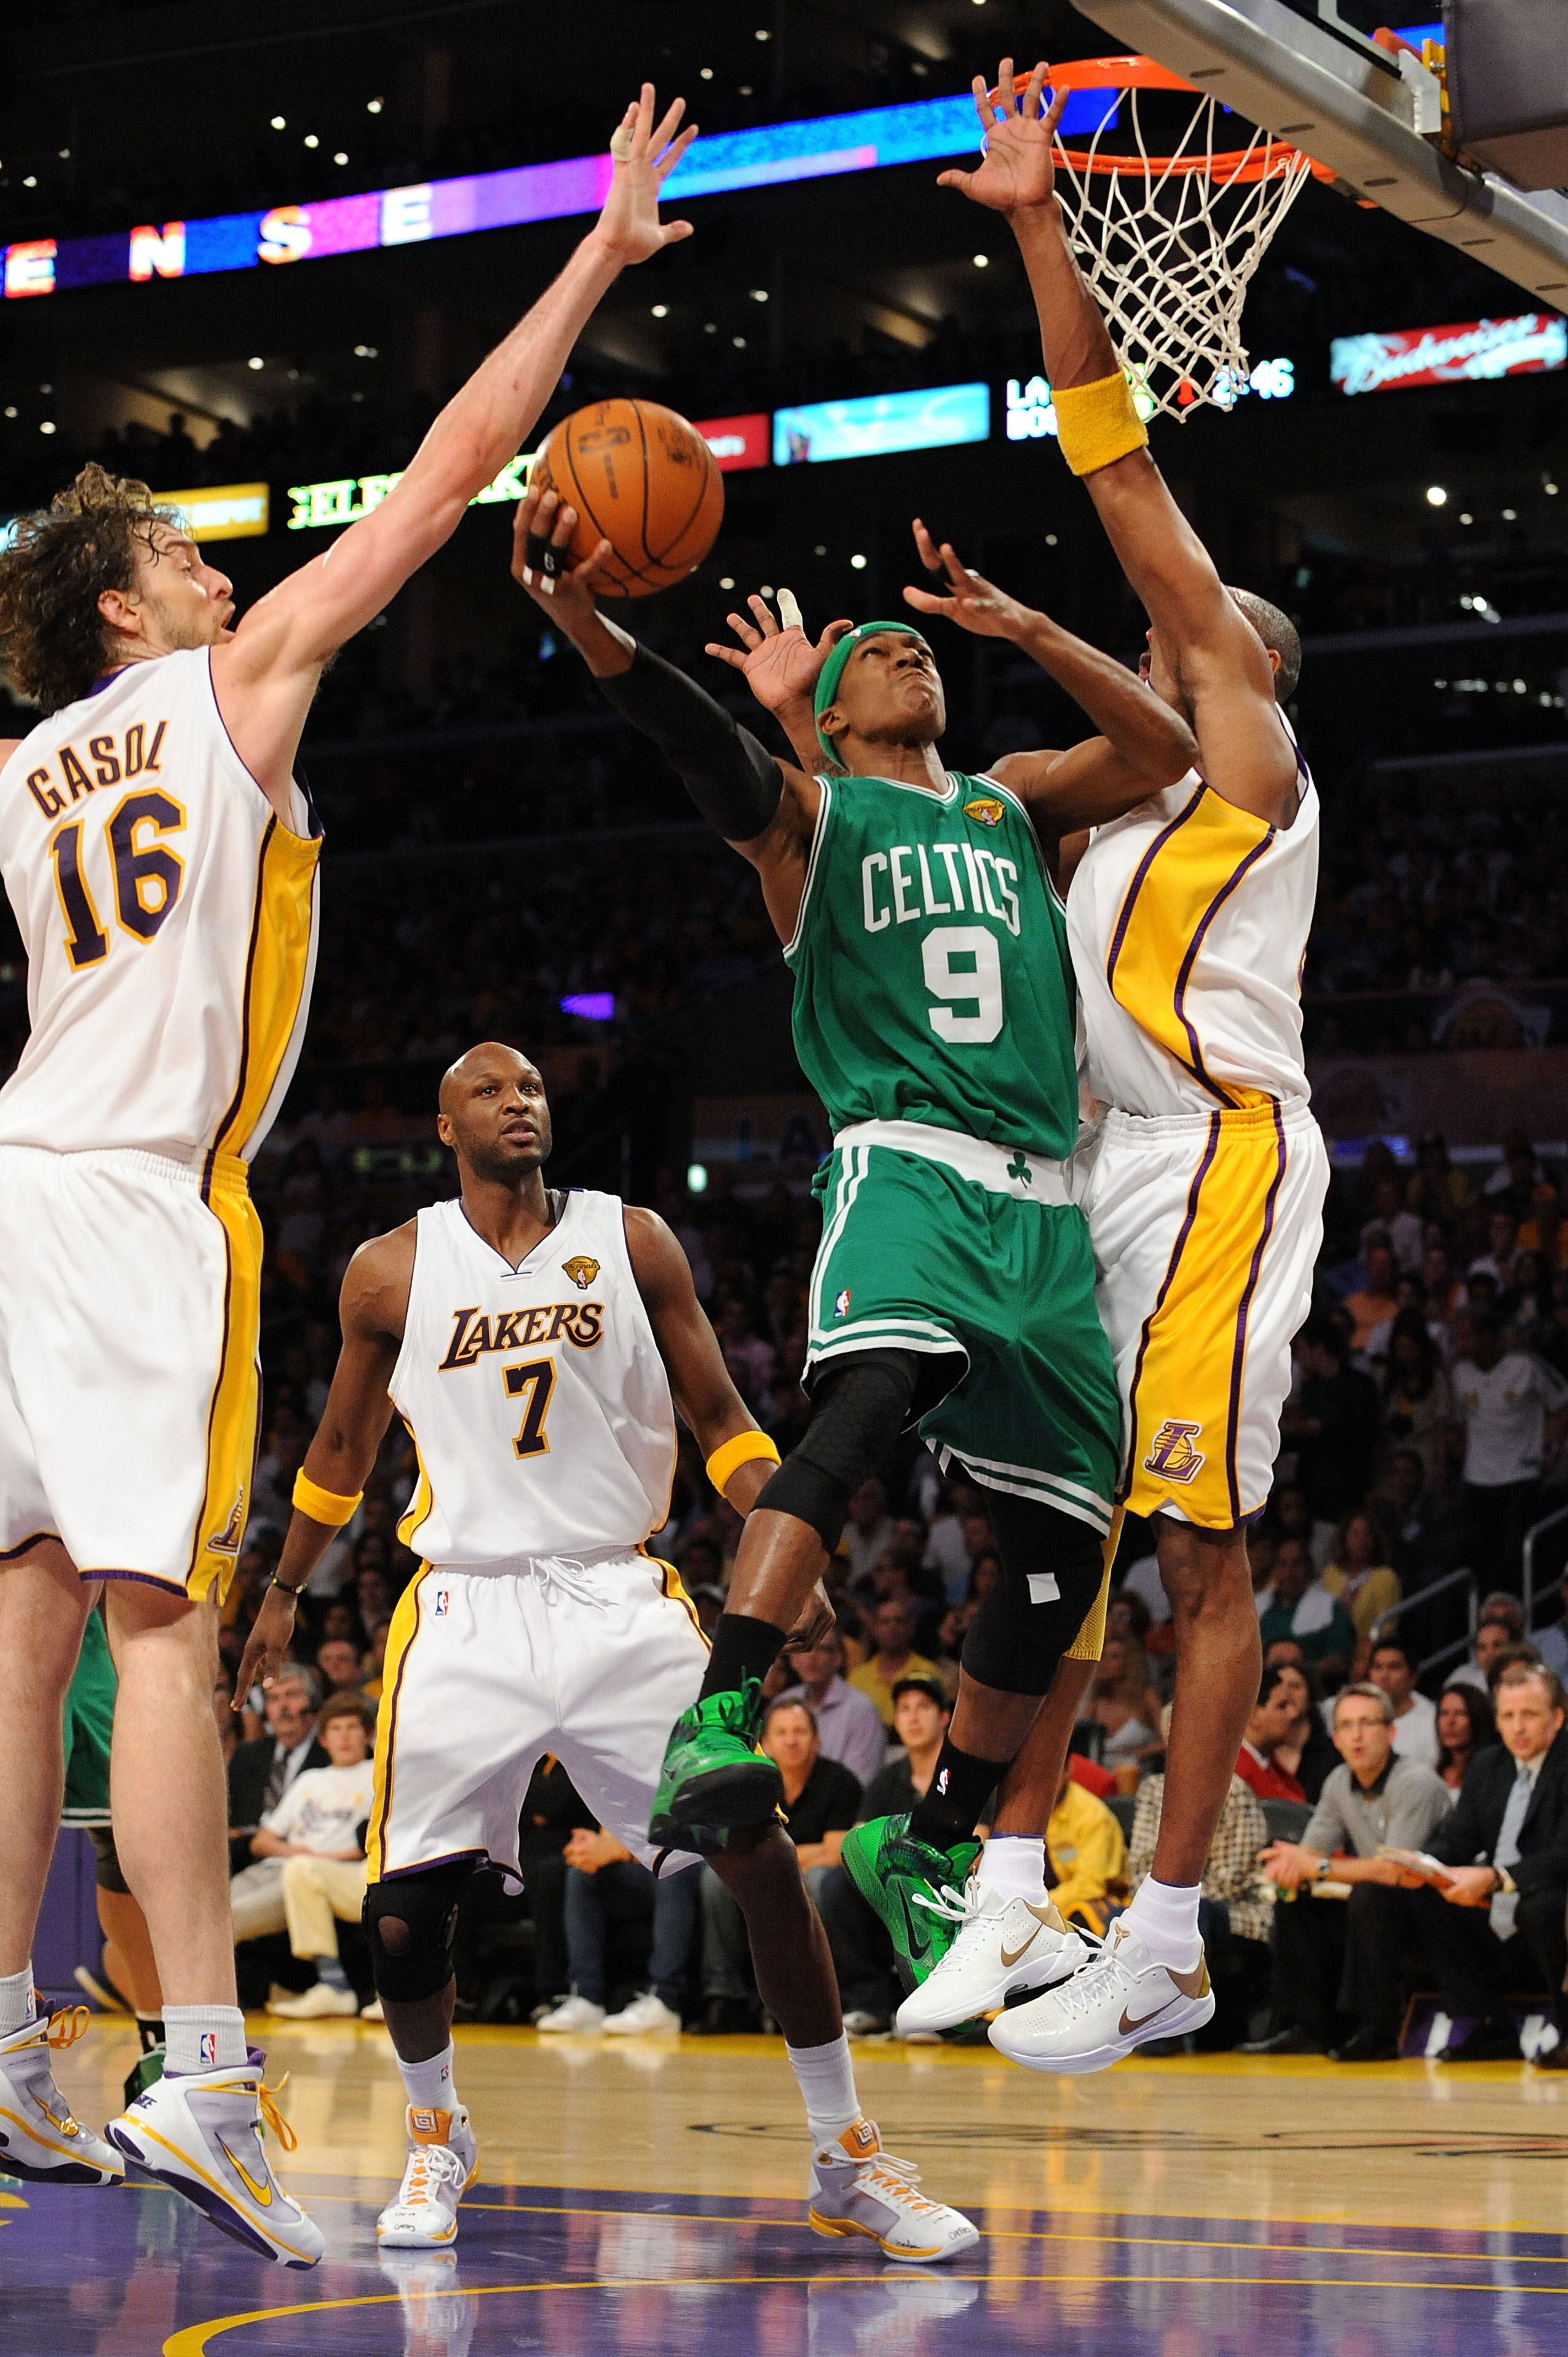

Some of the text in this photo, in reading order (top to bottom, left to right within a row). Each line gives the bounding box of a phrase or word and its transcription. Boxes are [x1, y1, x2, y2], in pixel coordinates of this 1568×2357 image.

[26, 720, 168, 821] GASOL
[48, 786, 187, 973] 16
[861, 843, 1021, 937] CELTICS
[921, 926, 1004, 1043] 9
[438, 1301, 605, 1373] LAKERS
[501, 1356, 558, 1460] 7
